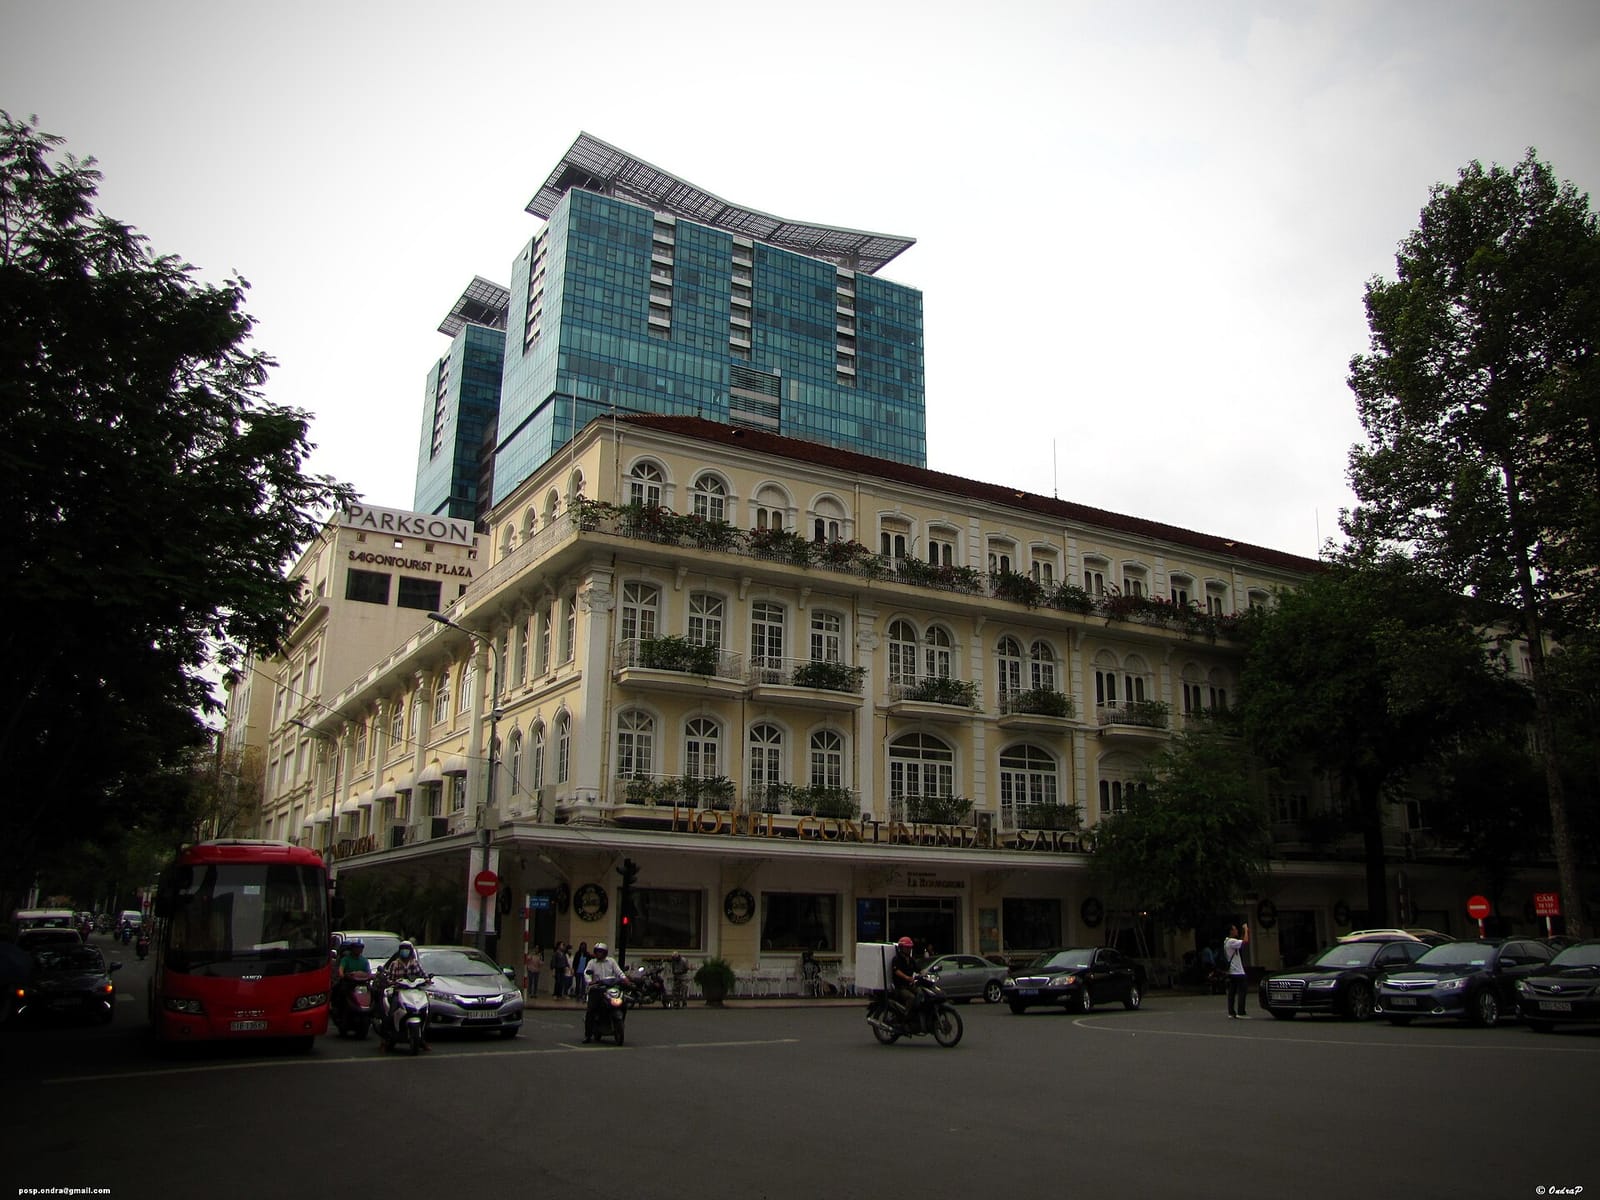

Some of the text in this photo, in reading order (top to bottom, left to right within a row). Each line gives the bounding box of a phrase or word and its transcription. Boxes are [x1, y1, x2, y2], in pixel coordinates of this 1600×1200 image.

[348, 505, 467, 541] PARKSON
[348, 550, 473, 578] SAIGONTOURIST PLAZA
[672, 806, 1097, 853] HOTEL CONTINENTAL SAIGO
